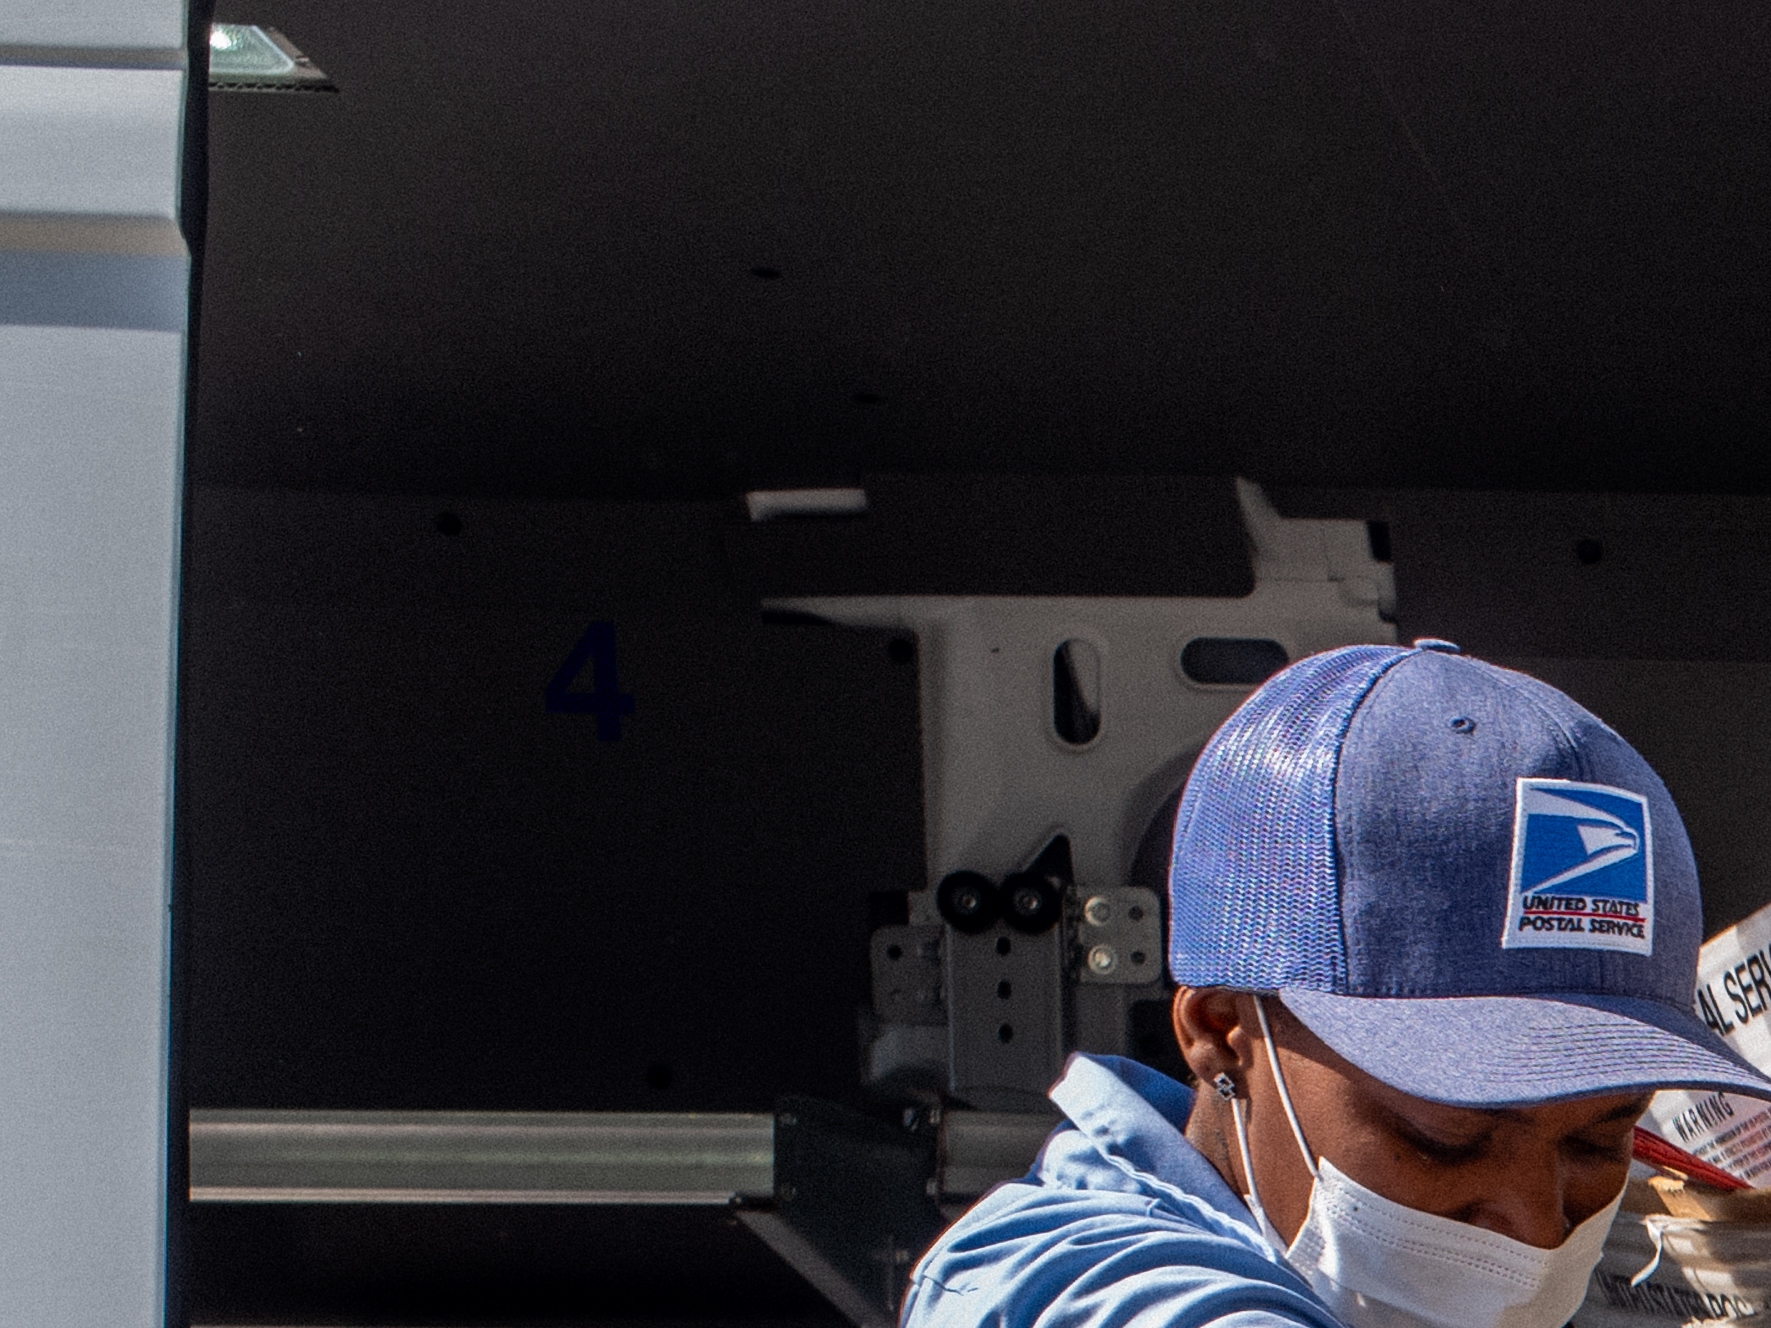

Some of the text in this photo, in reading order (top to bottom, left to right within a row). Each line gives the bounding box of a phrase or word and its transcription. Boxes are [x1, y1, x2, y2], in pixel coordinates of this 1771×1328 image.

[544, 620, 636, 743] 4
[1523, 895, 1640, 917] UNITED STATES
[1519, 917, 1645, 939] POSTAL SERVICE
[1672, 1091, 1734, 1143] WARNING
